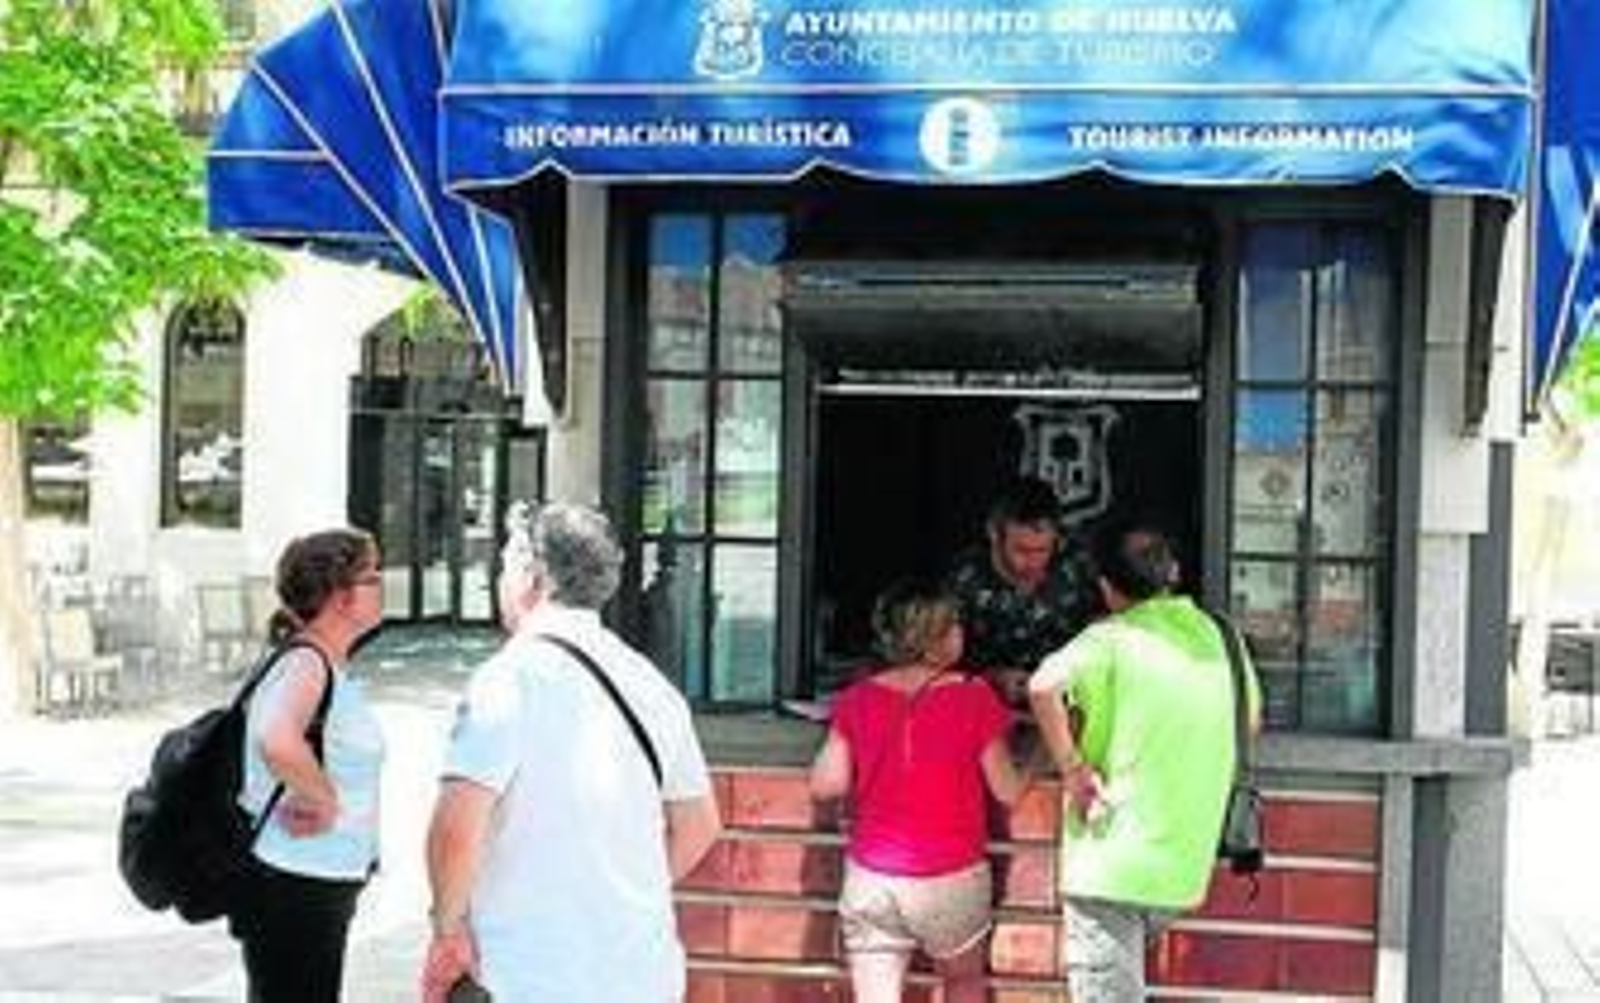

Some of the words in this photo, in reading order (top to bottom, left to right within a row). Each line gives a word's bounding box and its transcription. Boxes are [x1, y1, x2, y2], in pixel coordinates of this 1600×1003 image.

[785, 10, 1037, 35] AYUNTAMIENTO
[1049, 10, 1100, 34] DE
[1105, 8, 1237, 34] HUELVA
[1067, 124, 1193, 149] TOURIST
[1201, 124, 1413, 151] INFORMATION
